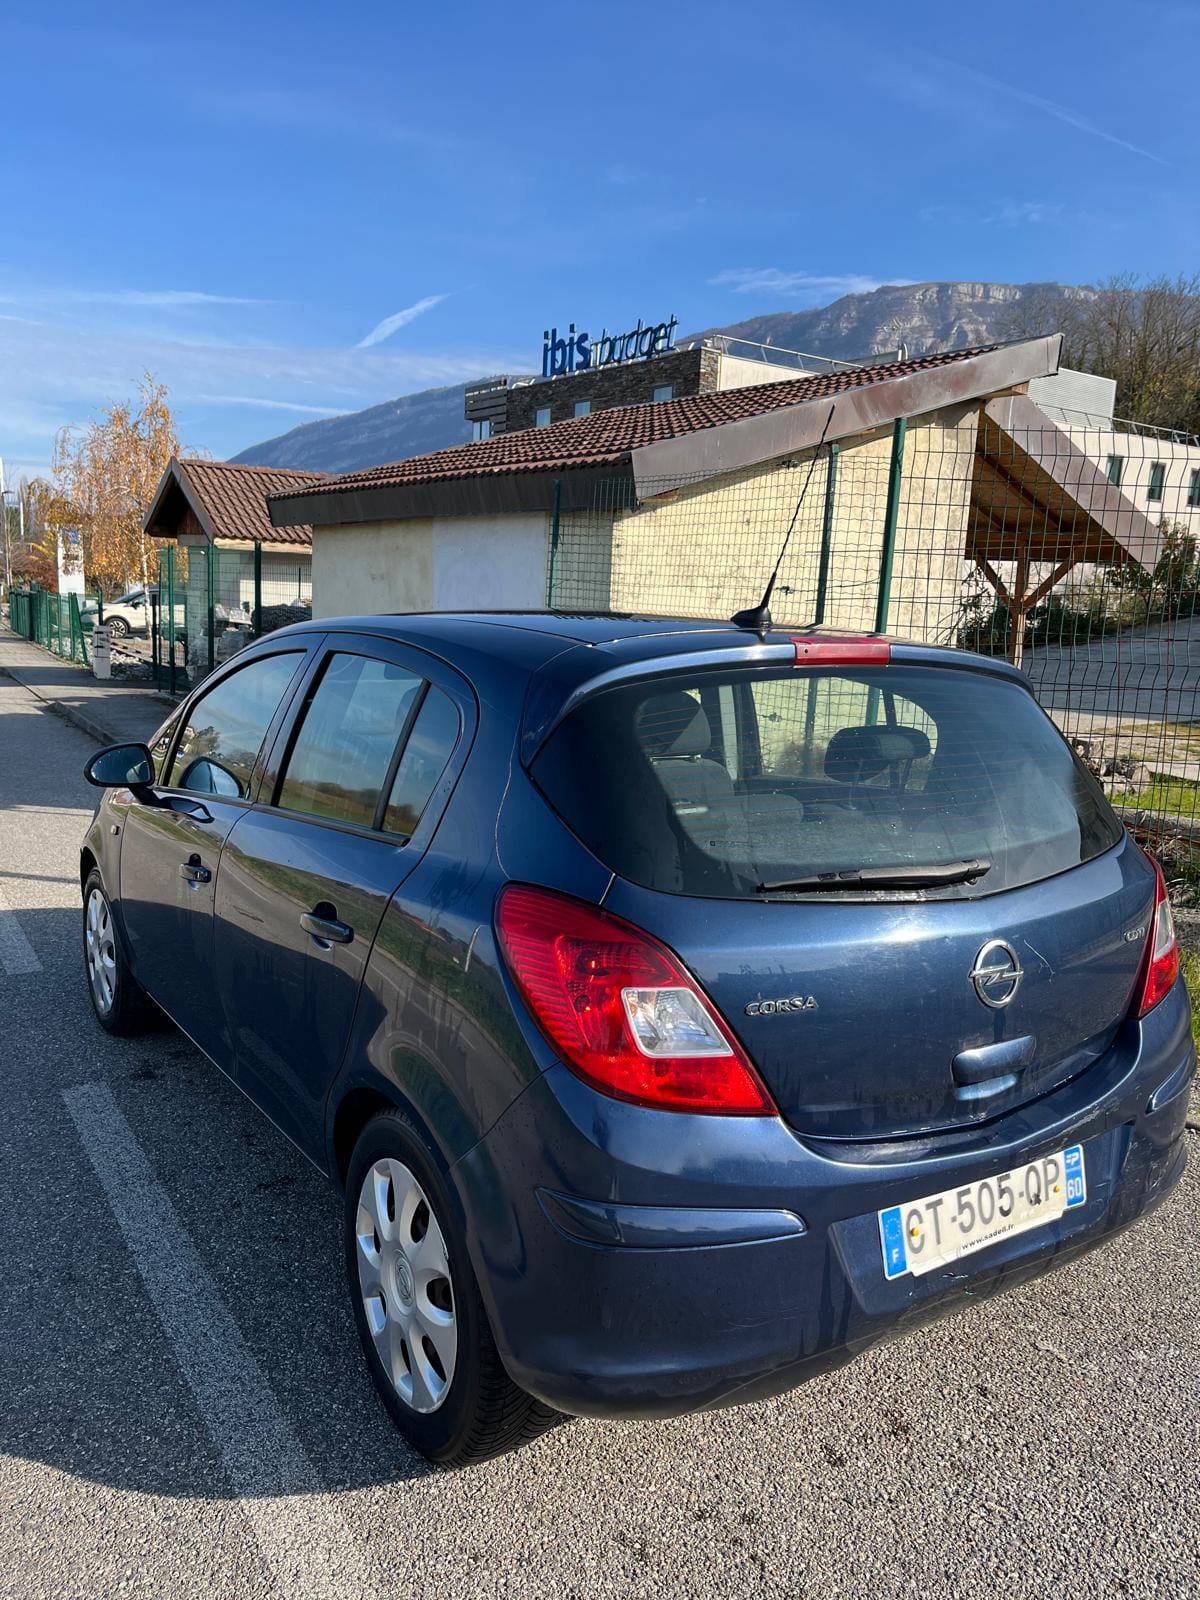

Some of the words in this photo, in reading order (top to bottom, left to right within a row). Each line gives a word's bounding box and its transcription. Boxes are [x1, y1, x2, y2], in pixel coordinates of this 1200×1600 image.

[542, 323, 590, 377] ibis
[599, 314, 678, 366] budget
[745, 996, 818, 1016] CORSA
[1067, 1176, 1083, 1199] 60
[892, 1248, 899, 1264] F
